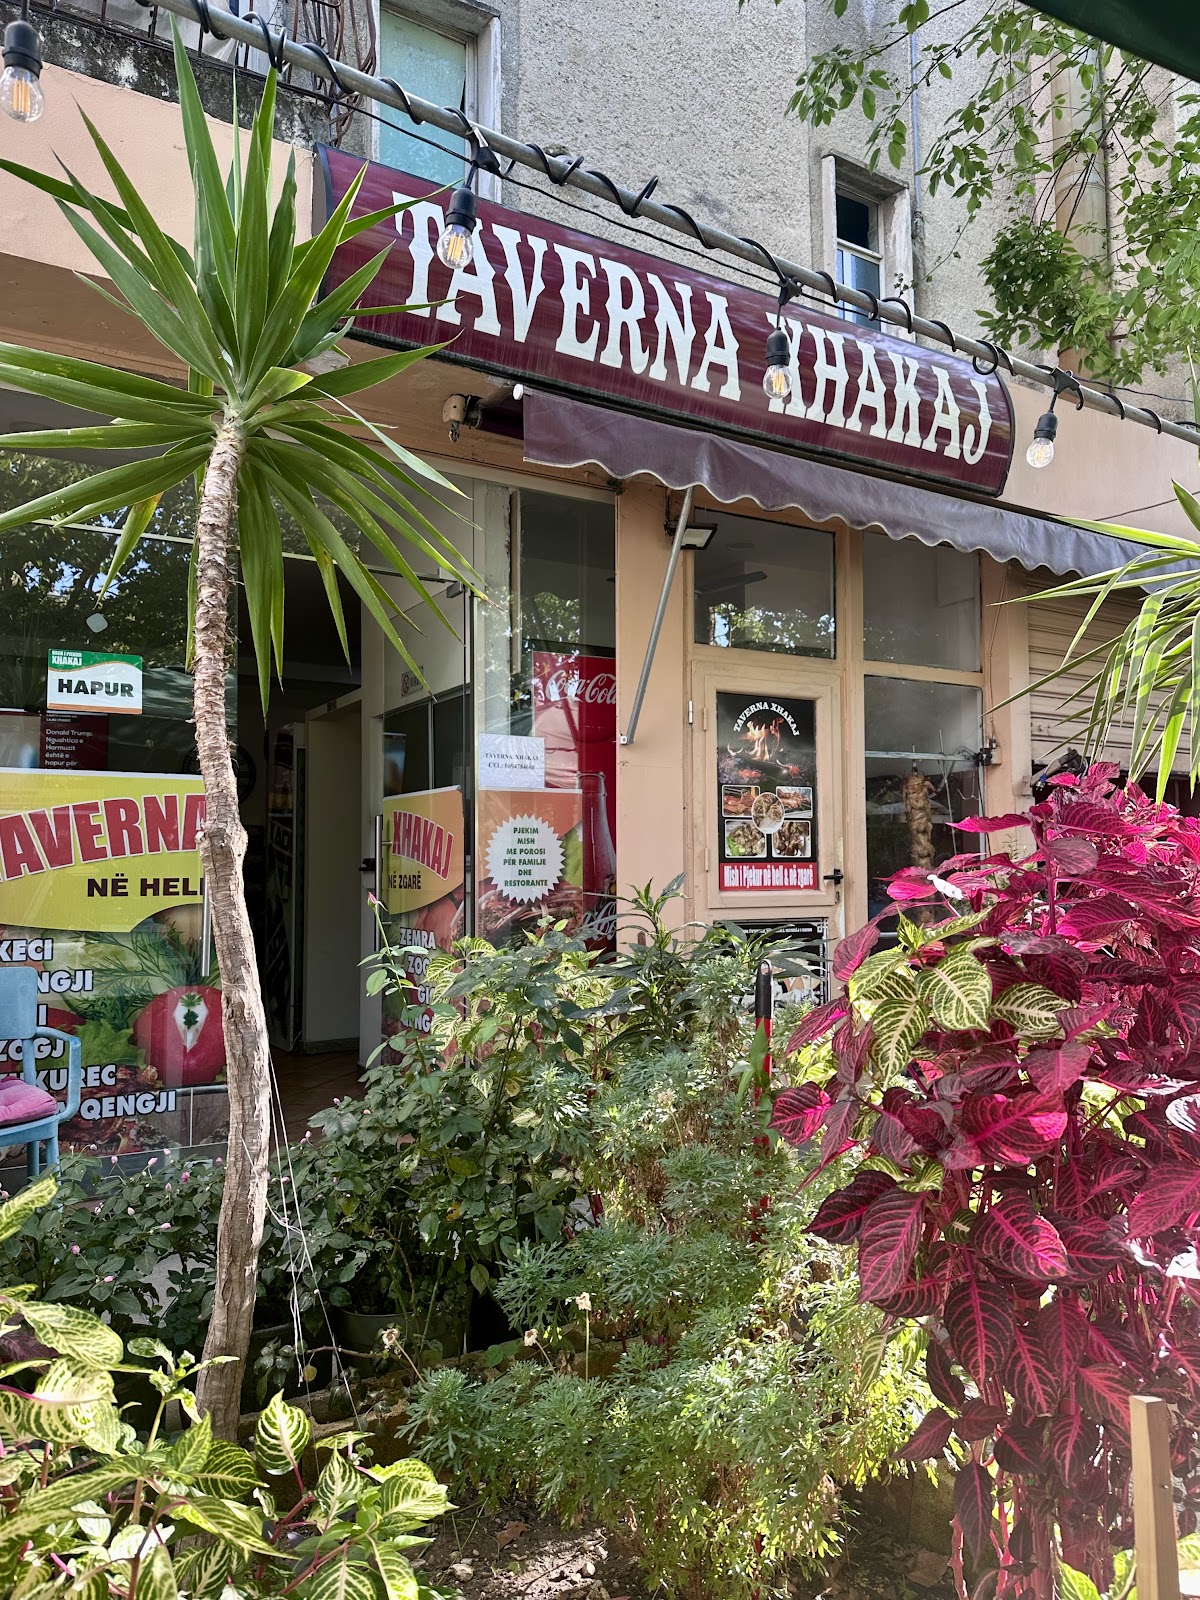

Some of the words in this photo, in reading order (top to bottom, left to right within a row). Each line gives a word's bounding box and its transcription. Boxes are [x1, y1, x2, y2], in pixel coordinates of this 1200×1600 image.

[392, 191, 741, 402] TAVERNA
[52, 656, 82, 666] XHAKAJ
[57, 678, 134, 698] HAPUR
[733, 702, 770, 733] TAVERNA
[770, 702, 800, 736] XHAKAJ
[46, 728, 70, 736] Donald
[70, 730, 94, 738] Trump:
[46, 737, 78, 745] Ngushtica
[45, 751, 64, 759] është
[45, 759, 66, 768] hapur
[0, 793, 206, 881] AVERNA
[392, 810, 454, 881] XHAKAJ
[503, 857, 516, 866] PËR
[87, 873, 129, 898] NË
[388, 871, 397, 889] NË
[398, 871, 422, 890] ZGARË
[504, 879, 548, 887] RESTORANTE
[723, 865, 739, 887] Mish
[743, 865, 762, 889] Pjekur
[400, 927, 437, 950] ZEMRA
[80, 1090, 177, 1121] QENGJI
